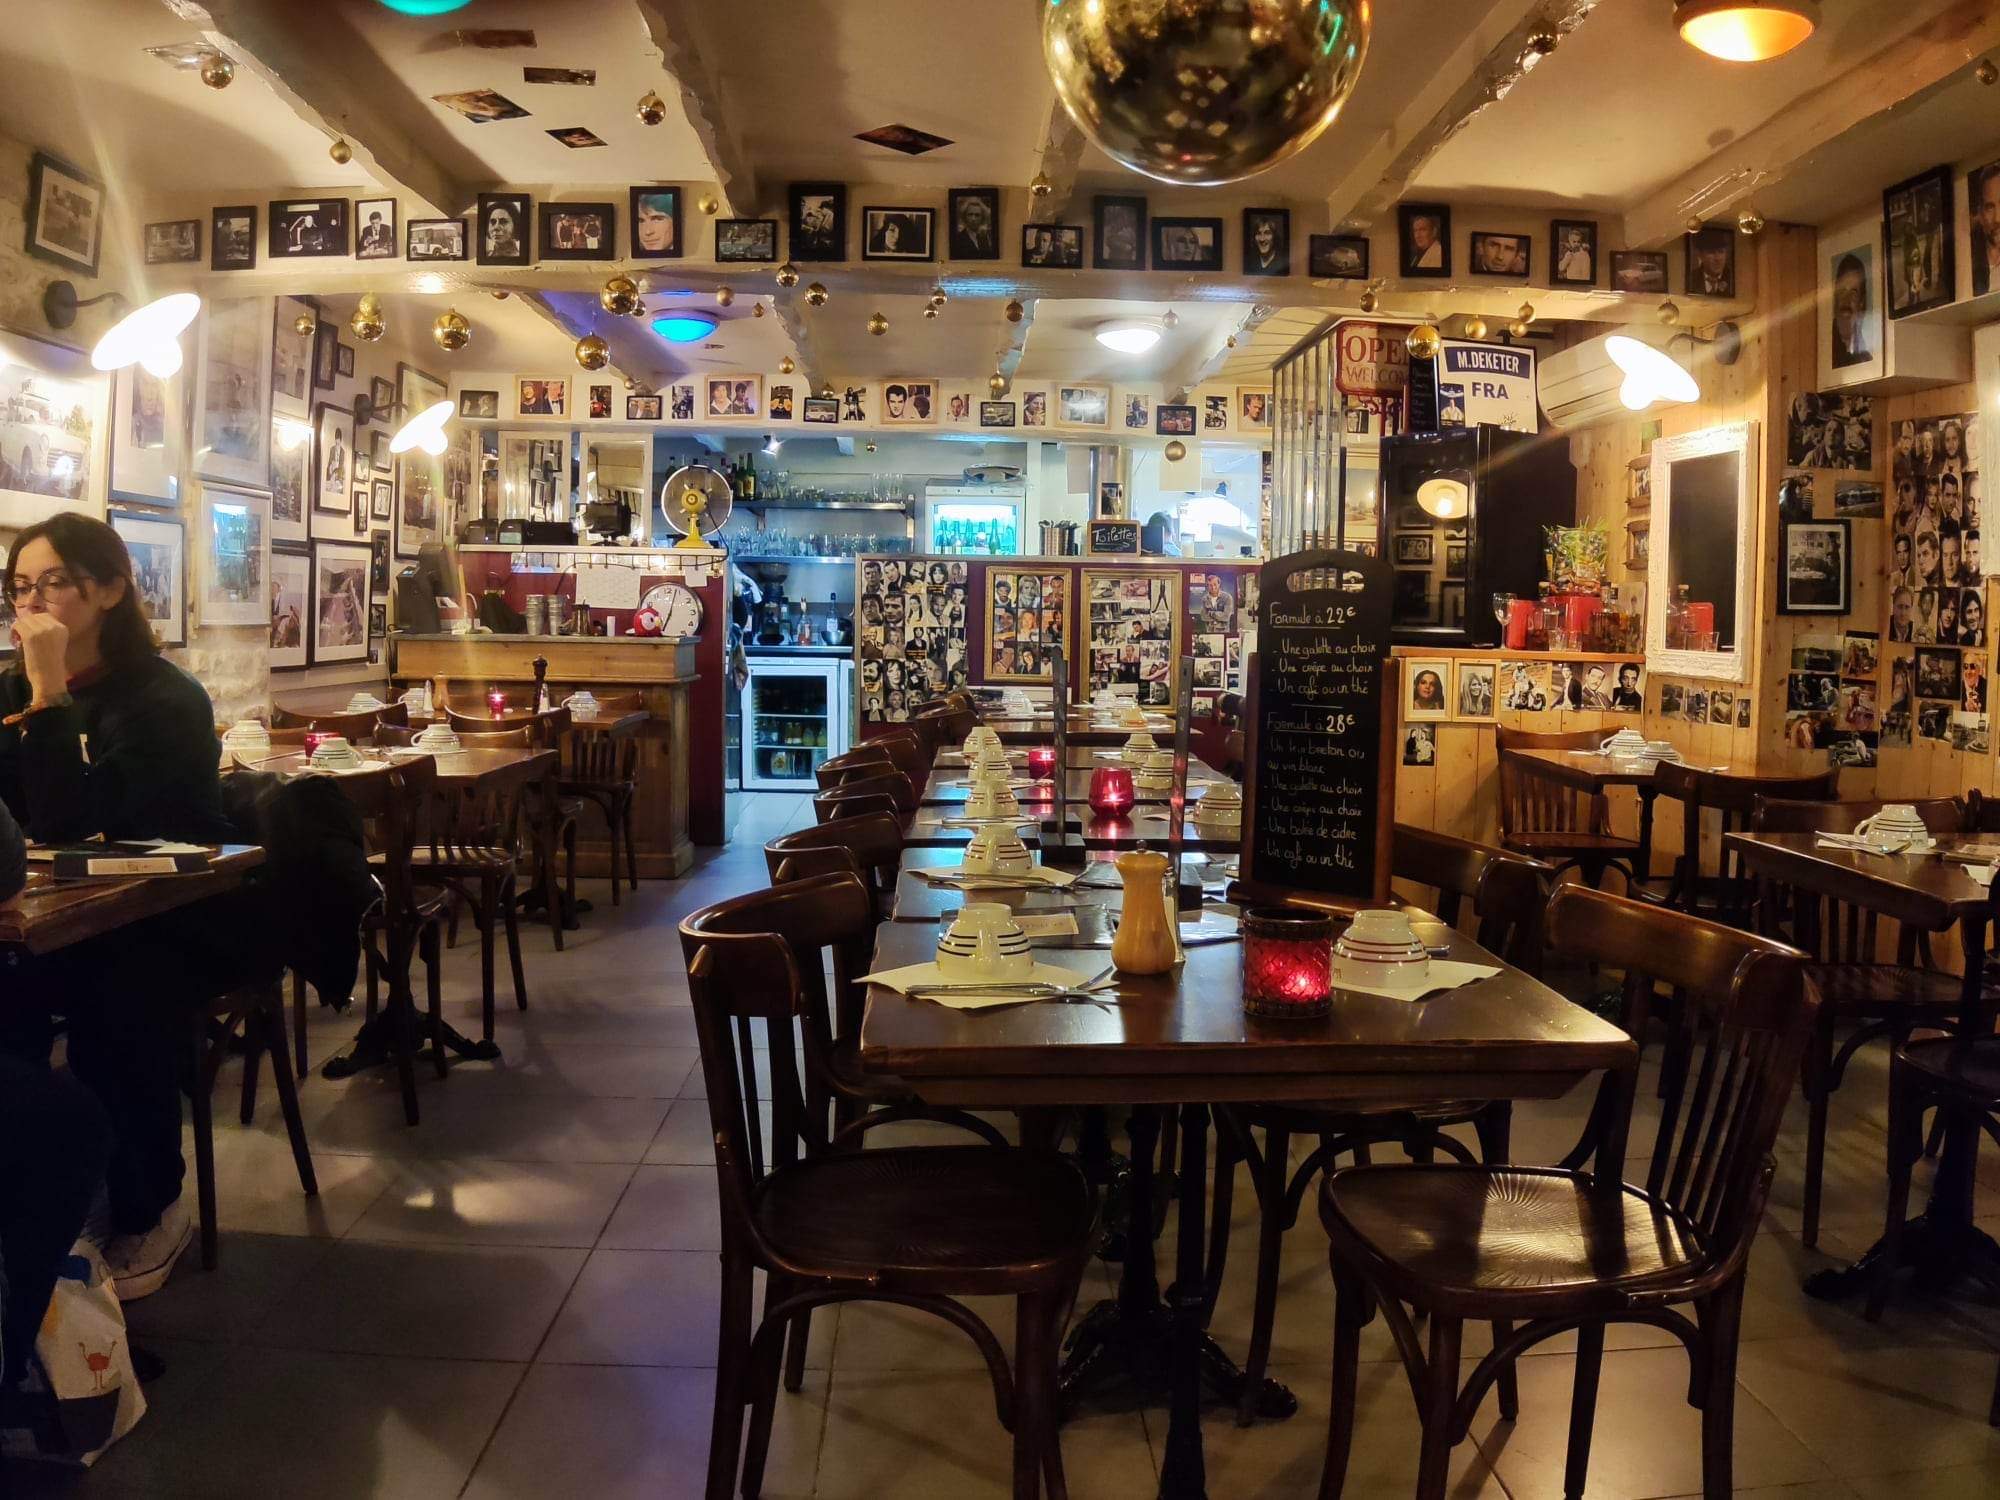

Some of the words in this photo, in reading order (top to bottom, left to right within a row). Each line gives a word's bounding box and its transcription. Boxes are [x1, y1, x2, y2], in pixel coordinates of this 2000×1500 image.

[1456, 351, 1519, 373] M.DEKETER
[1472, 382, 1509, 399] FRA
[1092, 526, 1137, 543] Toilettes
[1270, 601, 1312, 625] Formule
[1326, 606, 1357, 624] 22€
[1281, 637, 1300, 654] Une
[1335, 646, 1348, 654] au
[1351, 633, 1376, 653] choix
[1279, 657, 1297, 673] Une
[1331, 665, 1344, 673] au
[1346, 656, 1373, 672] choix
[1277, 677, 1296, 694] Un
[1322, 686, 1336, 694] ou
[1337, 685, 1349, 694] un
[1351, 675, 1369, 695] thé
[1267, 709, 1312, 730] Formule
[1326, 713, 1356, 733] 28€
[1348, 748, 1365, 759] ou
[1320, 785, 1334, 793] au
[1336, 776, 1363, 795] choix
[1319, 806, 1333, 814] au
[1337, 798, 1362, 816] choix
[1316, 816, 1328, 838] de
[1266, 840, 1280, 856] Un
[1306, 854, 1317, 863] ou
[1320, 856, 1333, 866] un
[1335, 843, 1354, 869] thé
